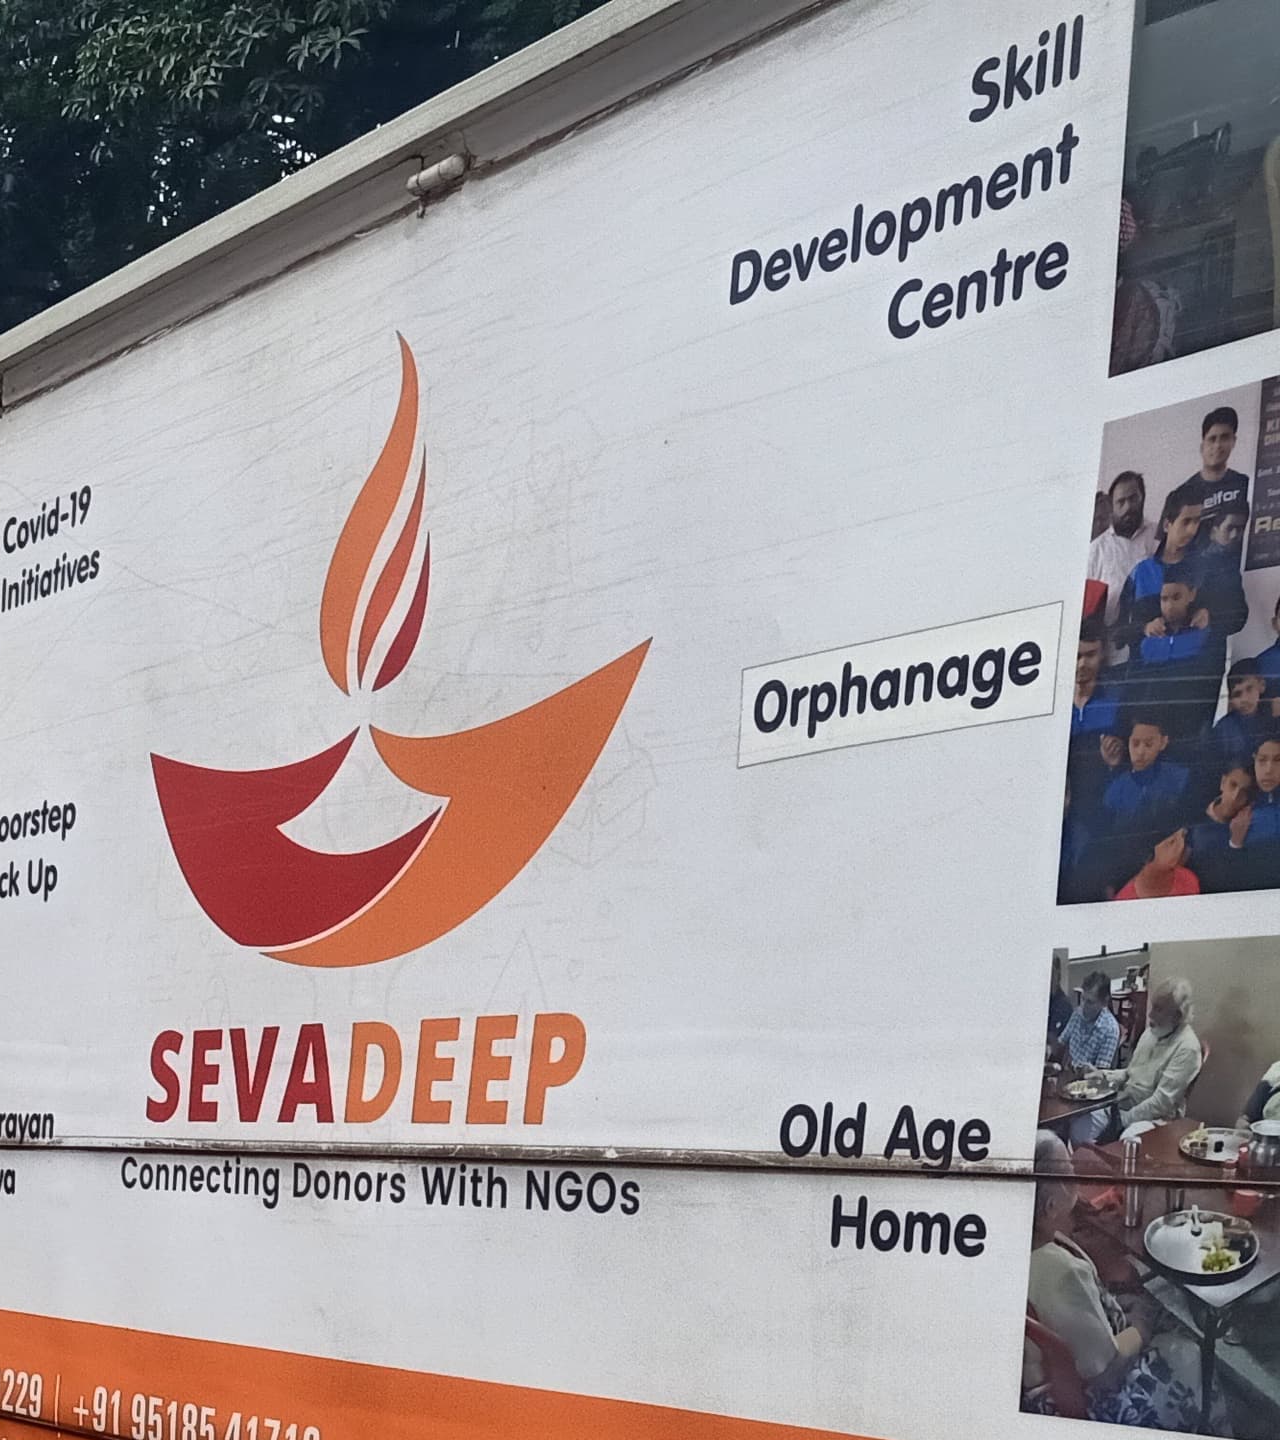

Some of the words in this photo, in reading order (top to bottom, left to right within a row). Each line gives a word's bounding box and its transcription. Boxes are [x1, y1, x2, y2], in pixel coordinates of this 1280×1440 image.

[969, 15, 1084, 123] Skill
[729, 123, 1080, 305] Development
[887, 241, 1070, 339] Centre
[2, 485, 92, 554] Covid-19
[1, 549, 100, 613] Initiatives
[753, 641, 1042, 738] Orphanage
[27, 859, 58, 902] Up
[146, 1013, 586, 1125] SEVADEEP
[780, 1102, 867, 1159] Old
[884, 1105, 991, 1178] Age
[121, 1156, 280, 1209] Connecting
[292, 1163, 406, 1203] Donors
[422, 1164, 508, 1209] With
[525, 1170, 641, 1215] NGOs
[831, 1194, 986, 1257] Home
[73, 1386, 121, 1437] +91
